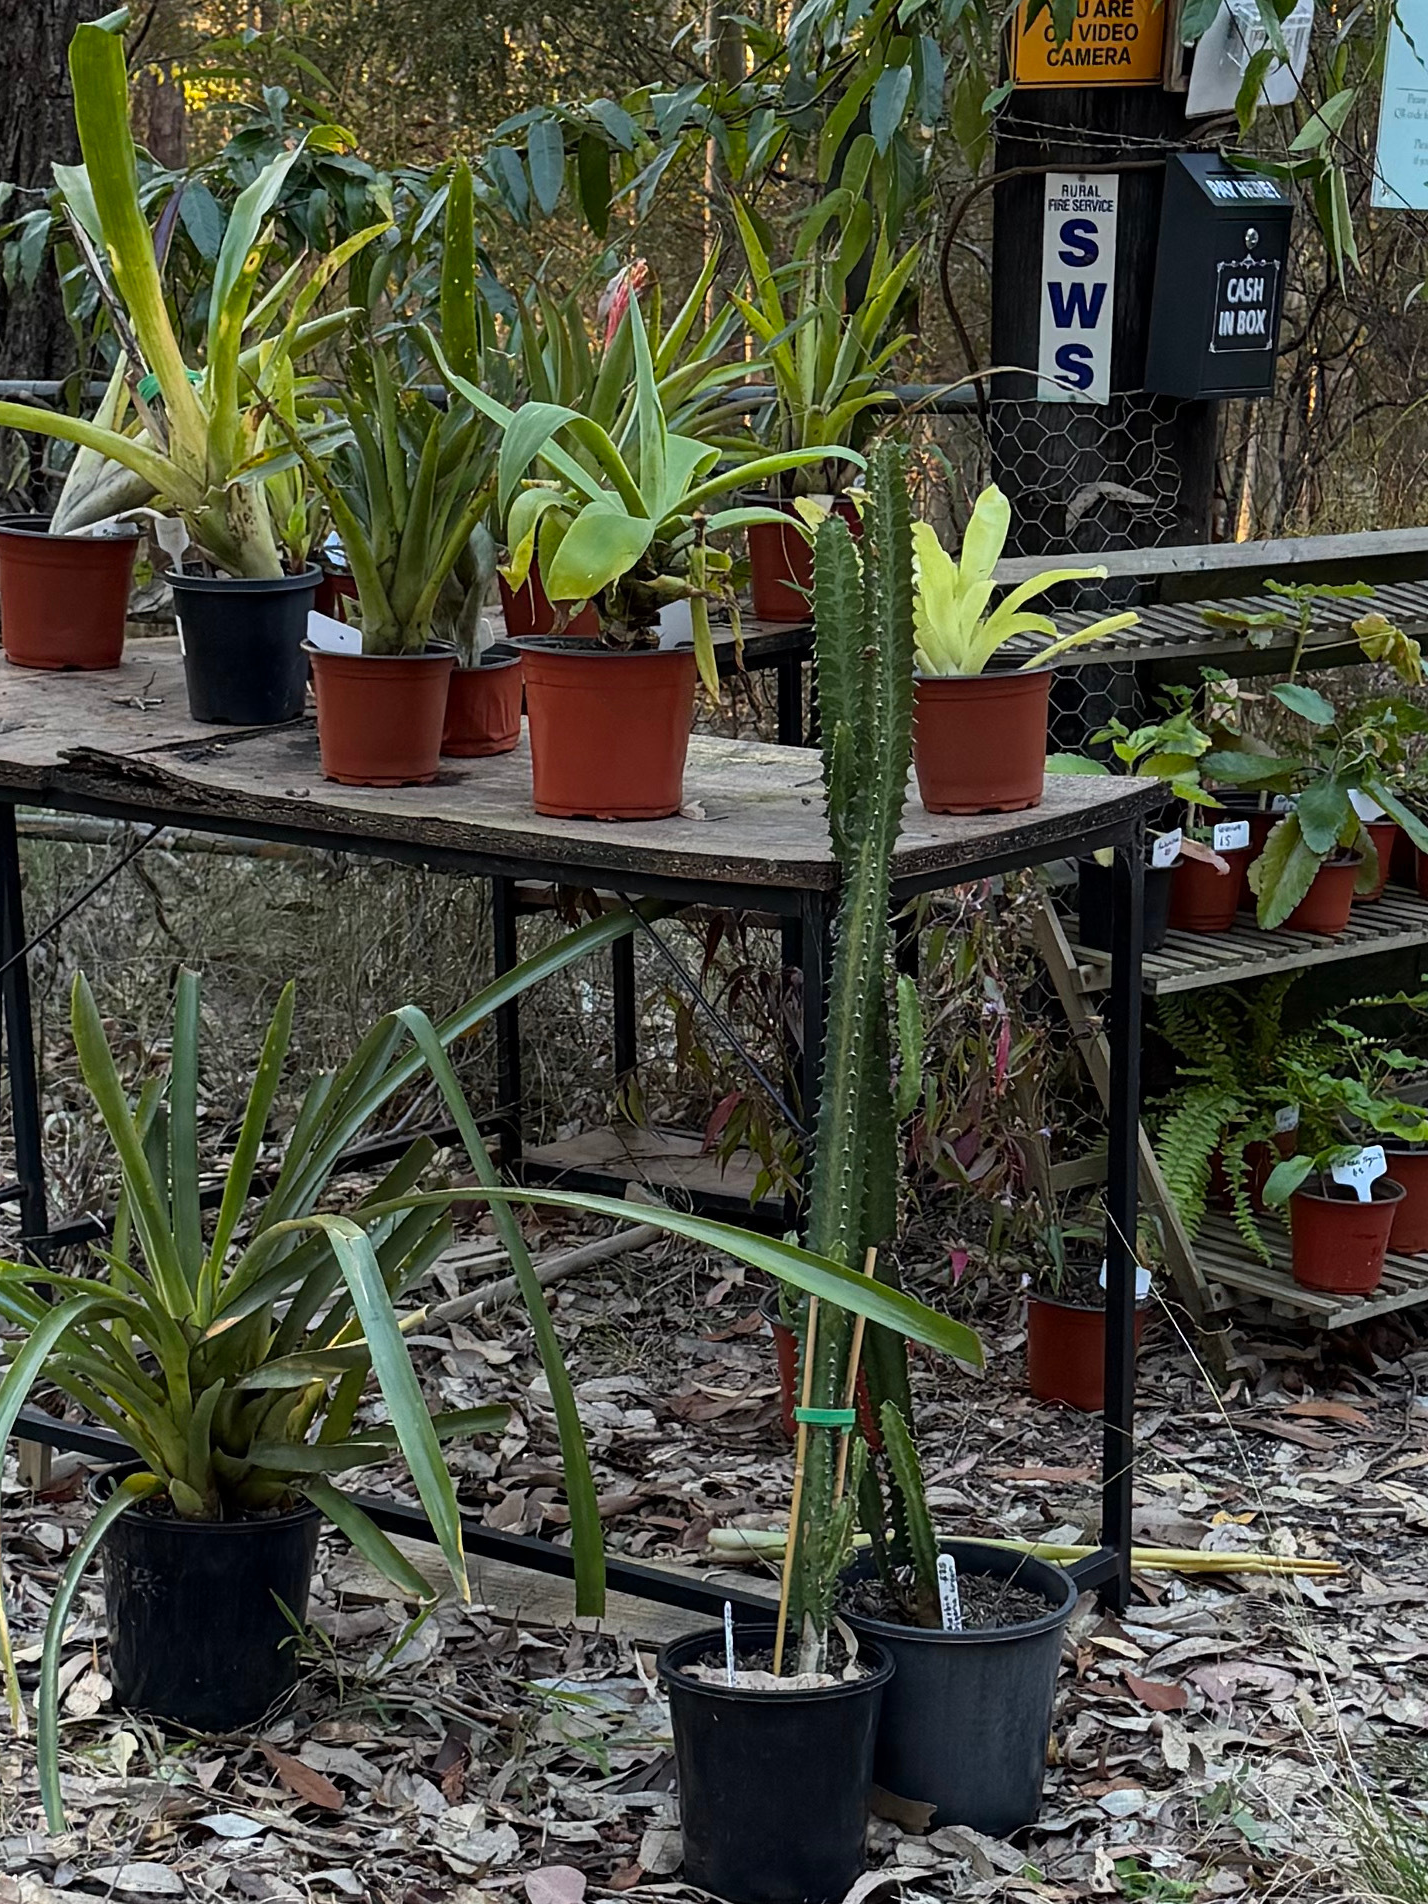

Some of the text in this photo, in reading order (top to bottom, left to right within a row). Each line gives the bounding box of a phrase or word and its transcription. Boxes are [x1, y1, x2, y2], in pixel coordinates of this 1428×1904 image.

[1093, 0, 1134, 18] ARE
[1078, 23, 1139, 42] VIDEO
[1046, 47, 1132, 67] CAMERA
[1061, 184, 1101, 198] RURAL
[1205, 179, 1239, 199] PAY
[1048, 198, 1114, 213] FIRE SERVICE
[1226, 277, 1265, 304] CASH
[1218, 309, 1267, 337] IN BOX
